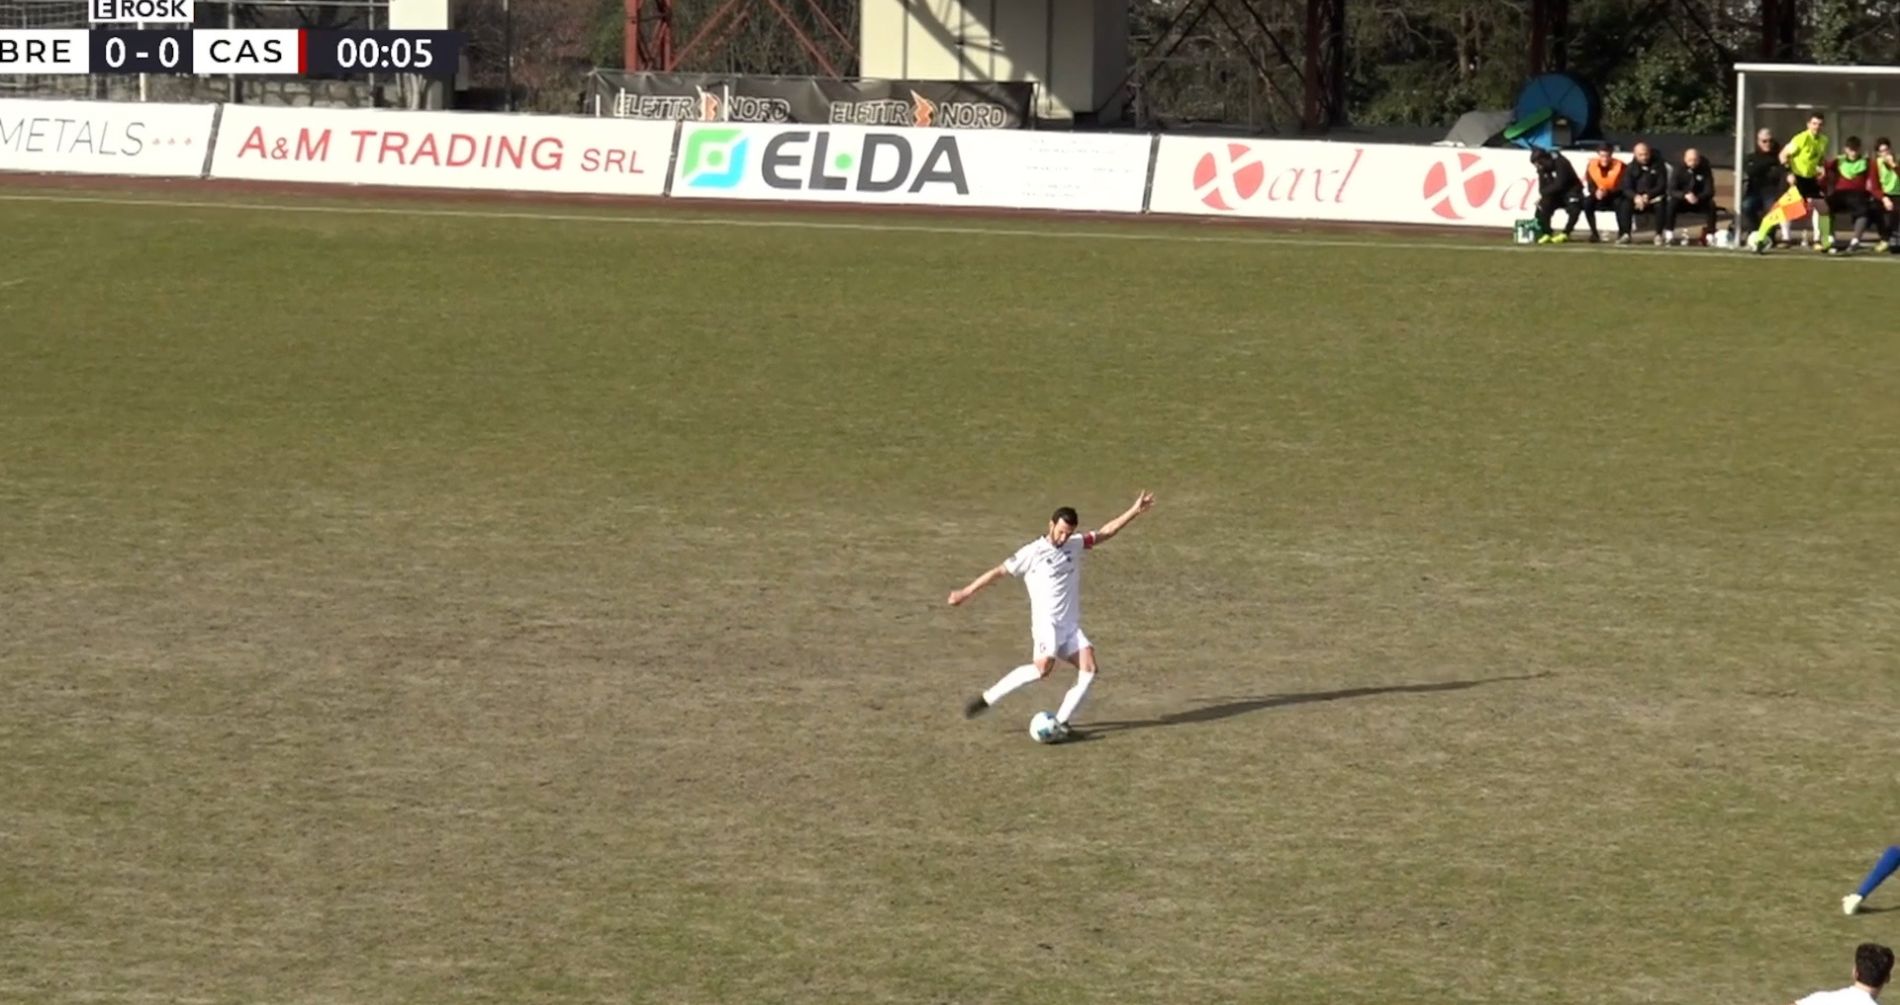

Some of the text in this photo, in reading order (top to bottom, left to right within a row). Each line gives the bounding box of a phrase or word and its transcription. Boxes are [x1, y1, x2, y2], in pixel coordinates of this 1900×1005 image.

[0, 118, 145, 157] METALS
[237, 125, 645, 174] A&M TRADING SRL
